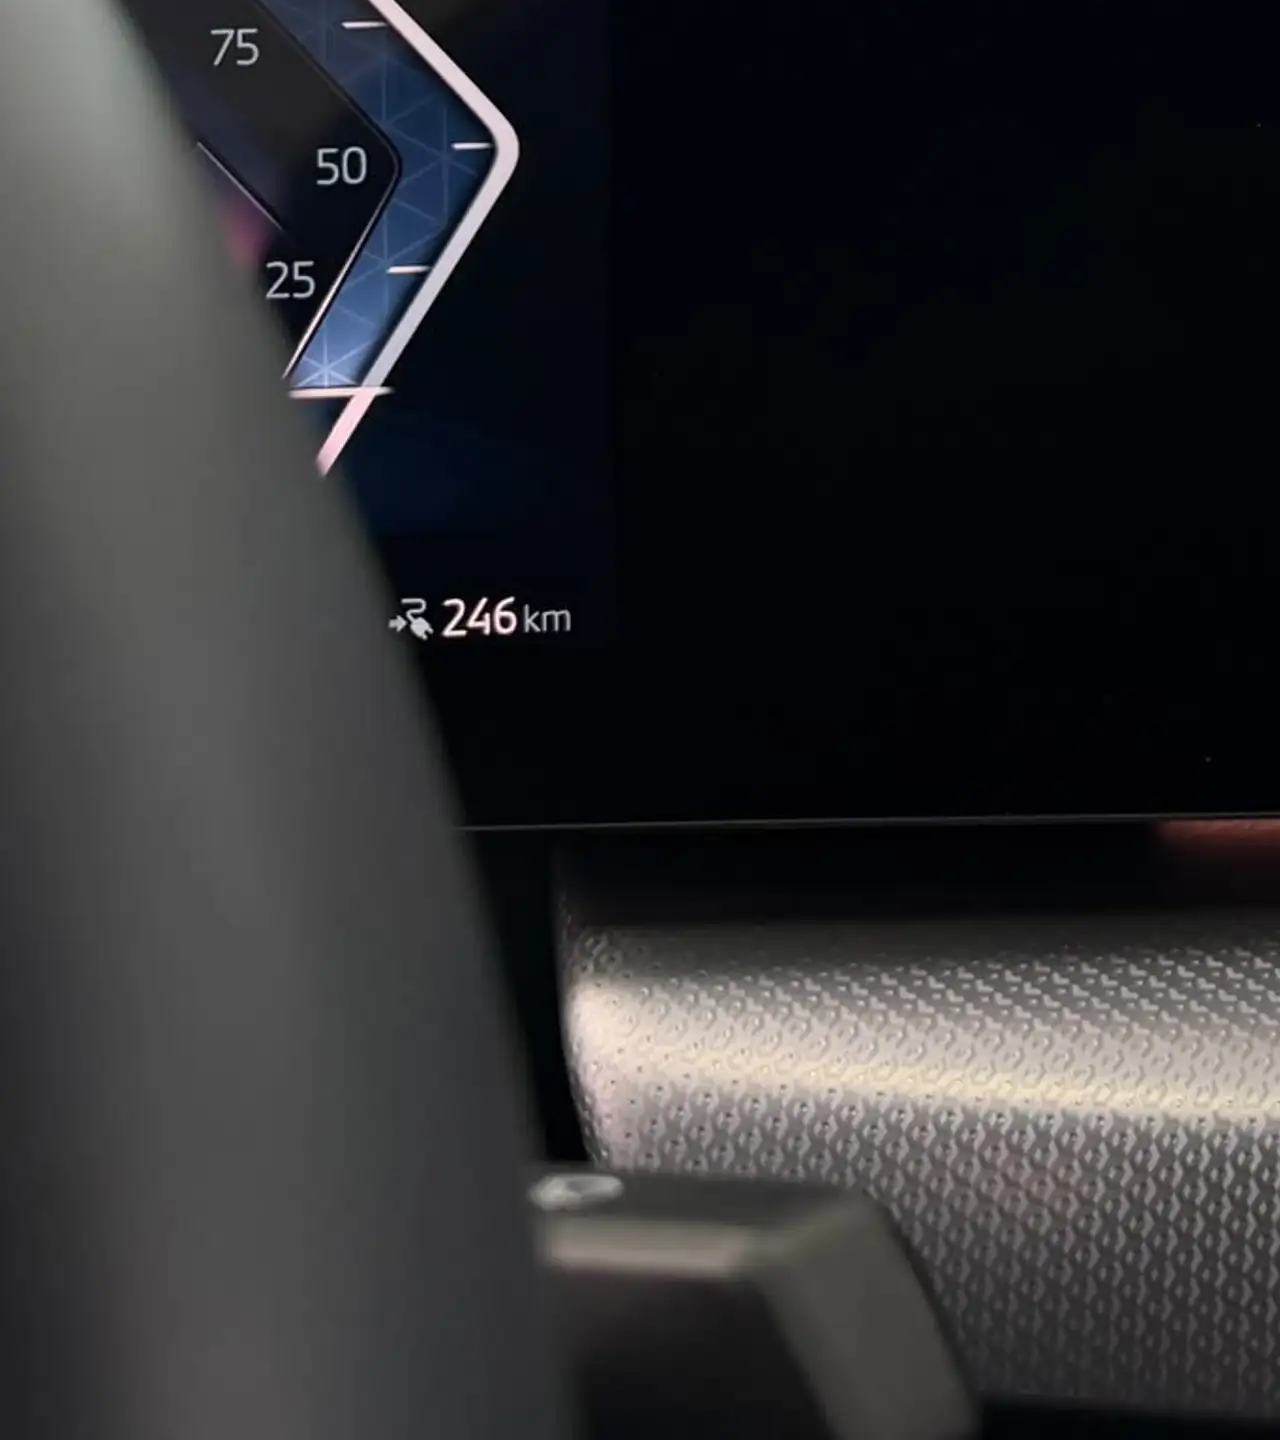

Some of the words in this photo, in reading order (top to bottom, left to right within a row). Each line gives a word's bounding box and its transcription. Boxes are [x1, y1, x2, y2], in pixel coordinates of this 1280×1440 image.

[210, 28, 259, 66] 75
[316, 146, 367, 186] 50
[265, 260, 315, 300] 25
[442, 596, 517, 637] 246
[523, 603, 571, 633] km
